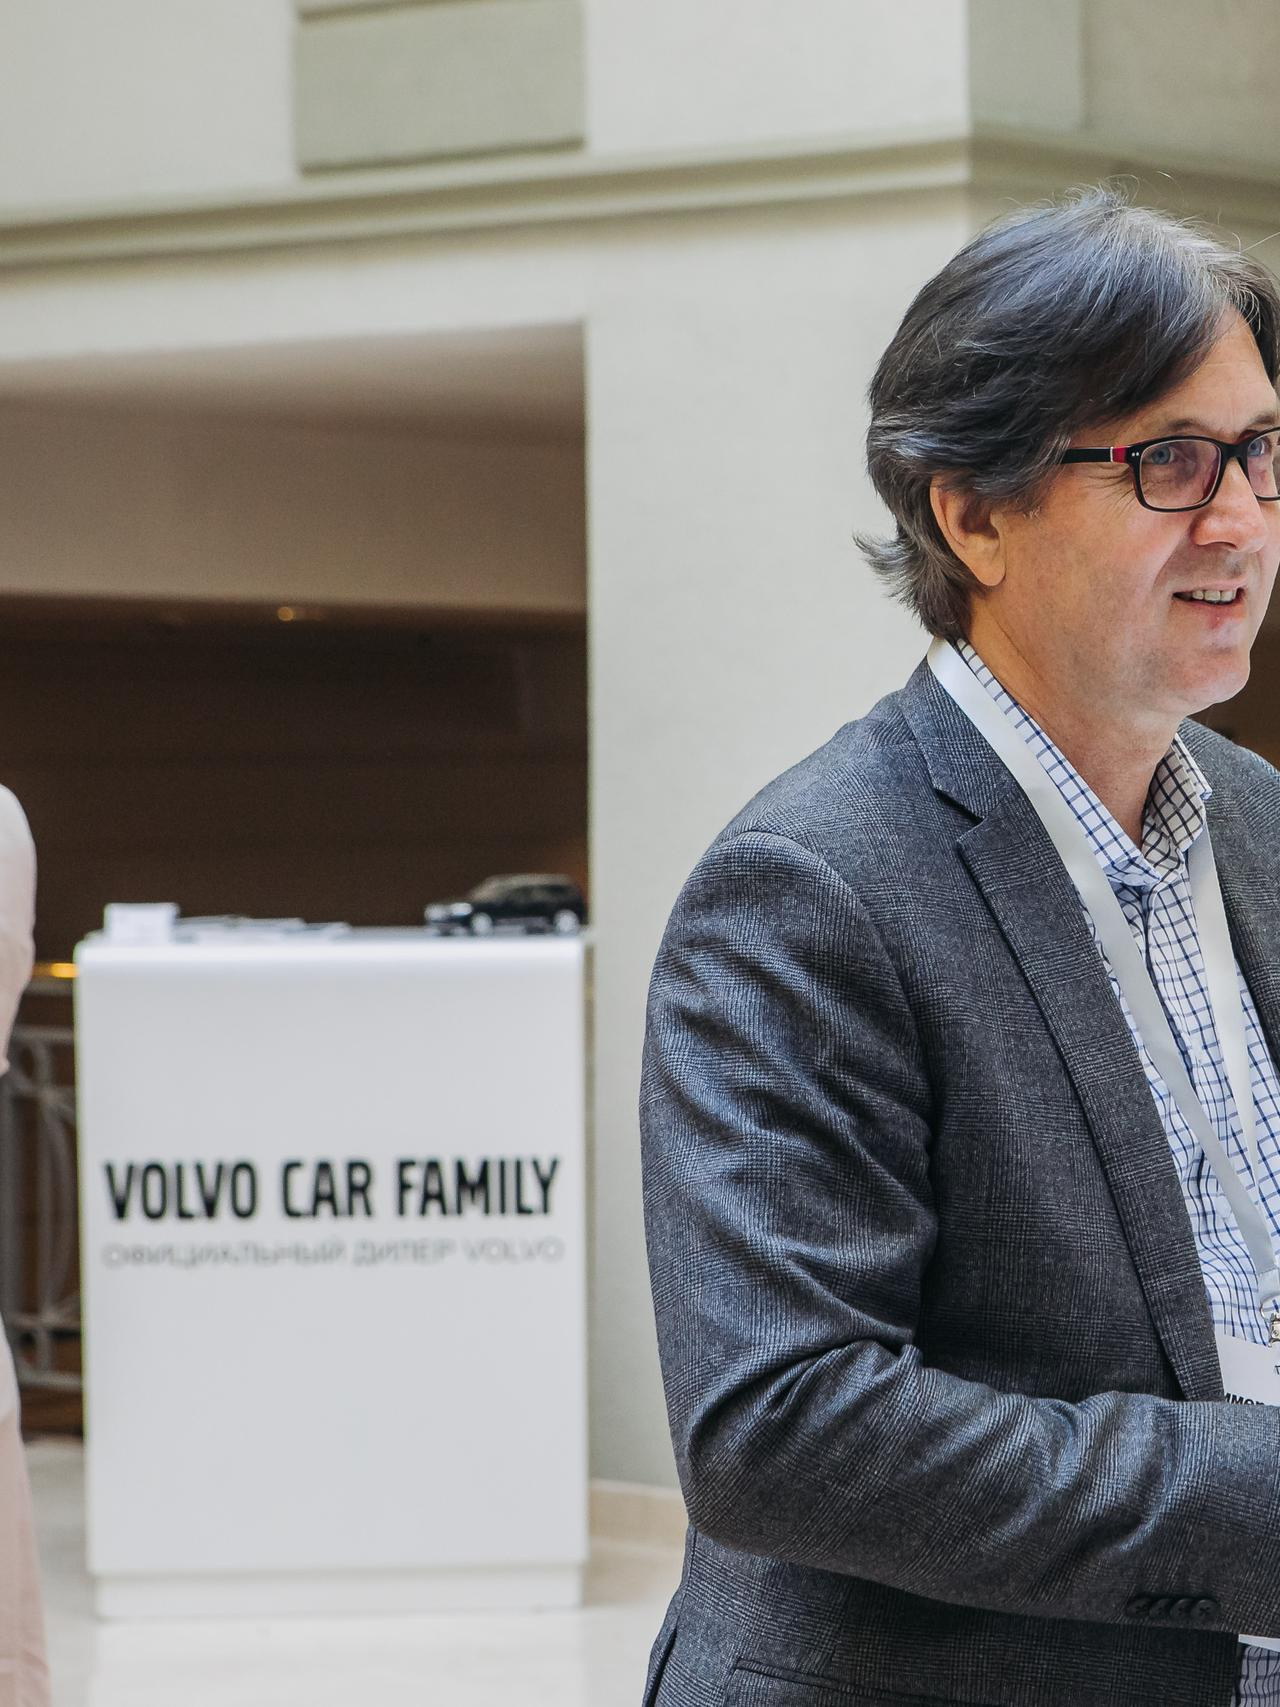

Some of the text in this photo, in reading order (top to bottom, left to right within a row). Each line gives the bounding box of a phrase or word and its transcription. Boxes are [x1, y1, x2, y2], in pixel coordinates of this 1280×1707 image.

[103, 1158, 559, 1221] VOLVO CAR FAMILY
[352, 1237, 457, 1267] ДИЛЕР
[461, 1236, 566, 1265] VOLVO
